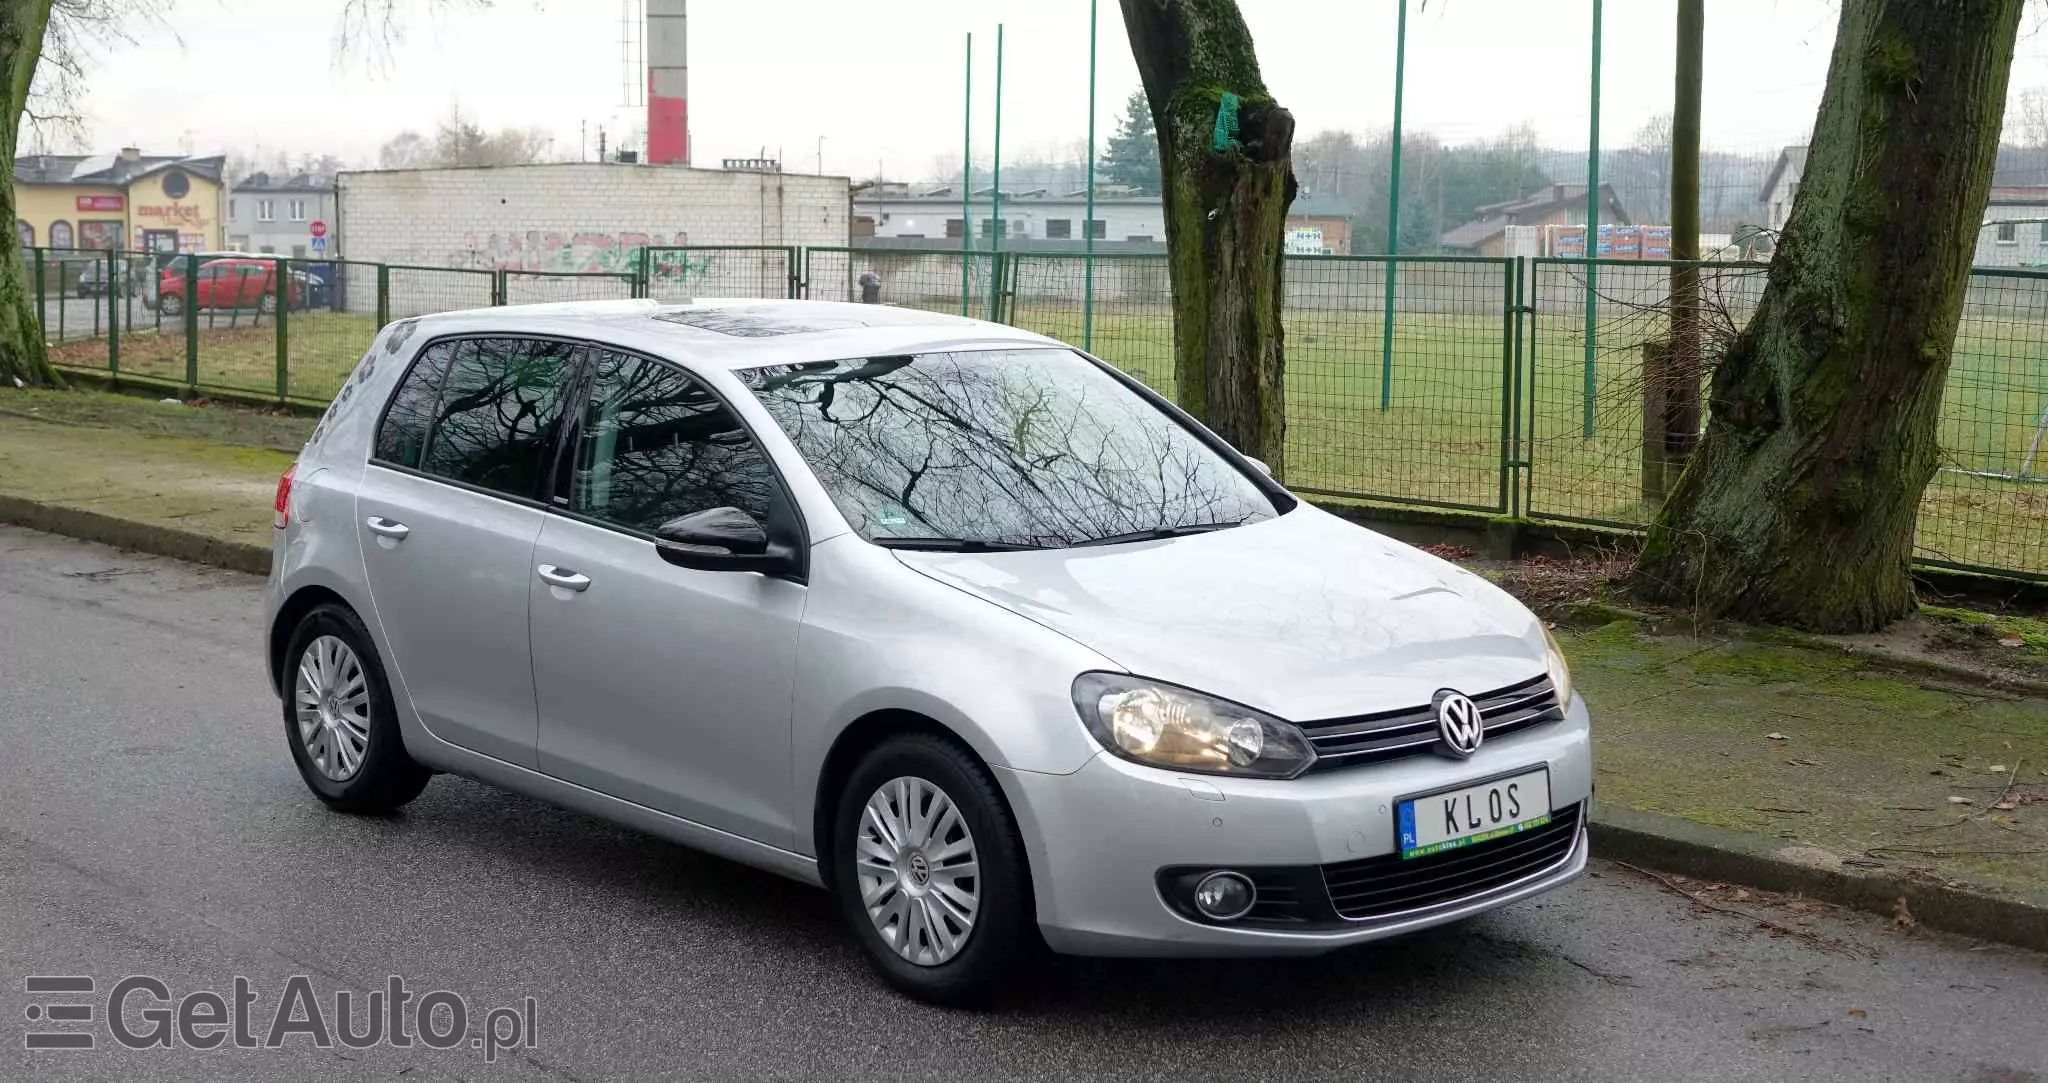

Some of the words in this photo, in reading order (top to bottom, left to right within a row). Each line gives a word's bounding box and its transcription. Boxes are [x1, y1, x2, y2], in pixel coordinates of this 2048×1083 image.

[137, 202, 200, 221] market
[1445, 783, 1521, 834] KLOS
[1403, 832, 1416, 845] PL
